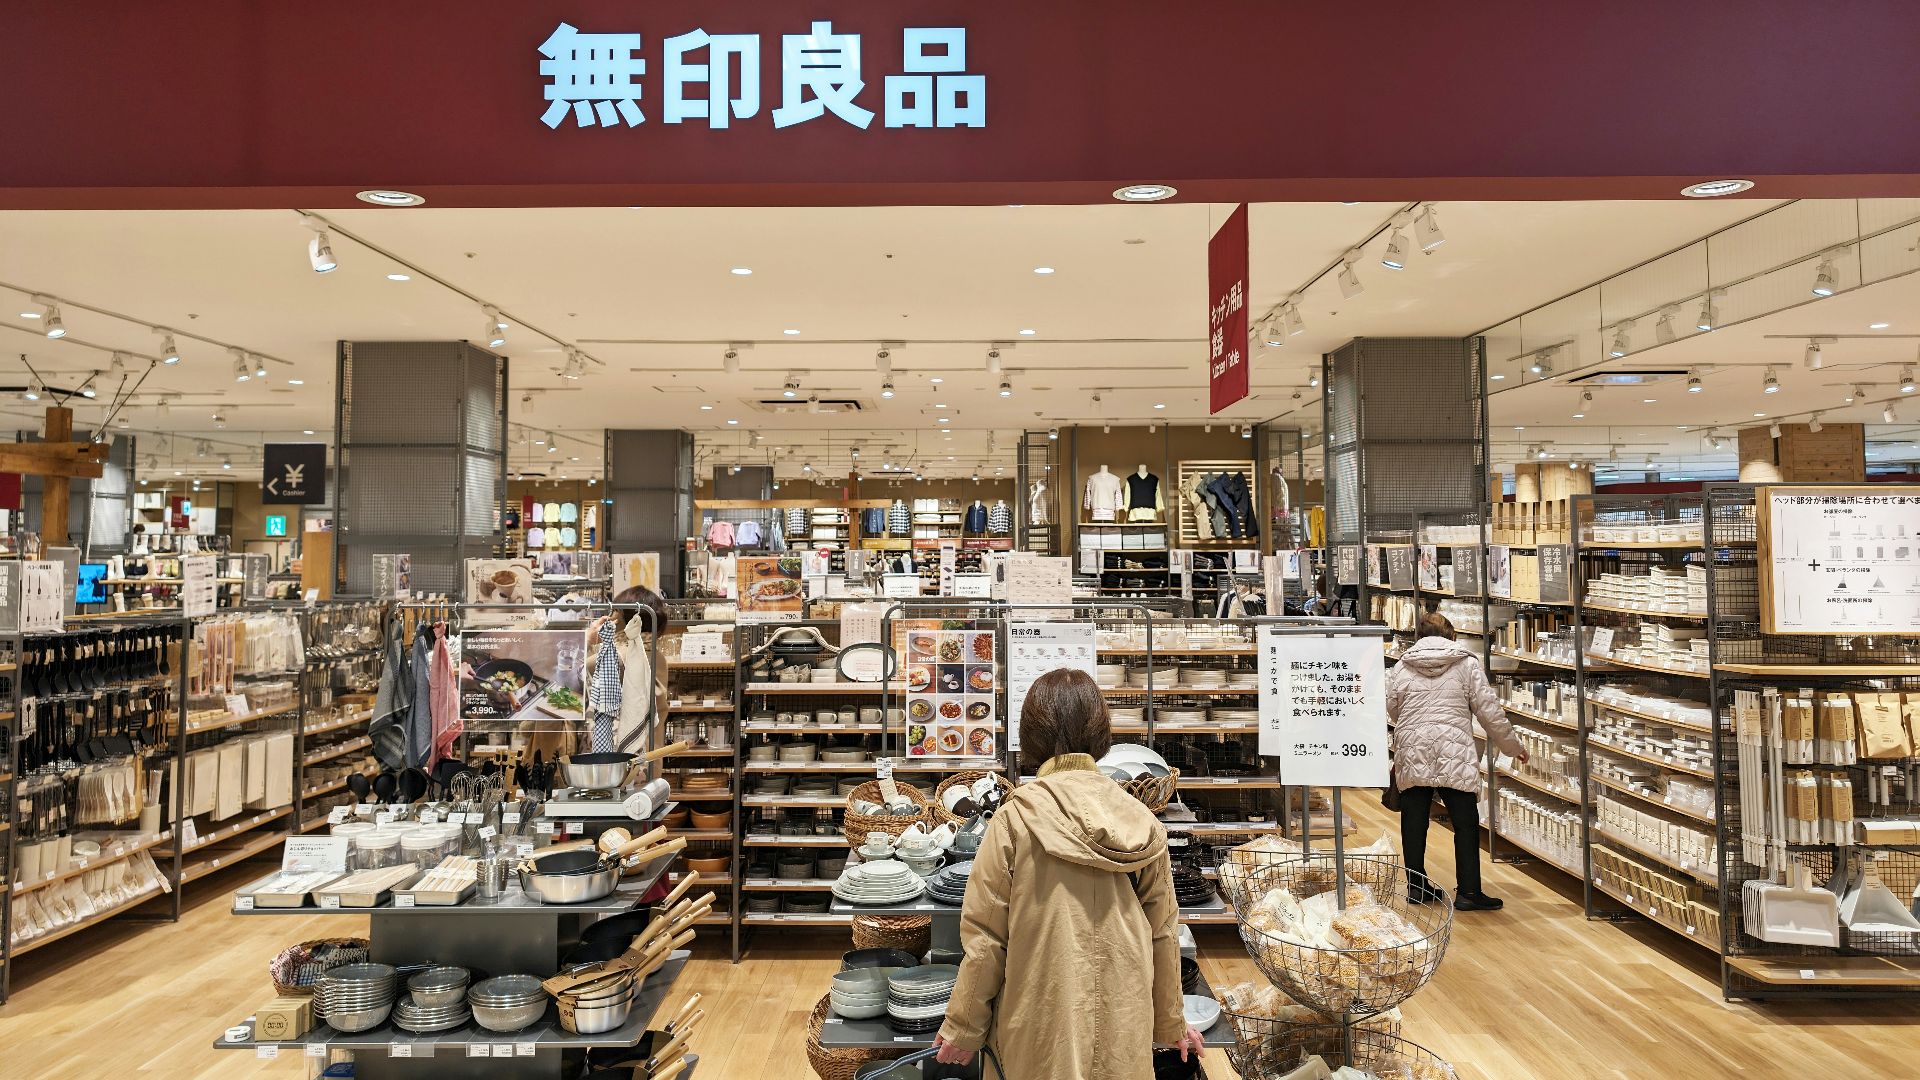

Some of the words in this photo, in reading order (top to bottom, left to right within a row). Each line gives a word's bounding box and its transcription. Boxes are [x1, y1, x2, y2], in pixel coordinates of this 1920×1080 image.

[538, 21, 986, 130] 無印良品
[1211, 279, 1243, 330] キッチン用品
[1212, 326, 1224, 360] 食器
[1392, 549, 1400, 574] コンテナ
[1398, 549, 1406, 568] フード
[1457, 549, 1465, 572] 弁当箱
[1464, 549, 1473, 584] マグボトル
[1543, 547, 1554, 582] 保存容器
[1552, 547, 1562, 573] 冷水筒
[1290, 661, 1348, 670] 麺にチキン味を
[1290, 673, 1362, 682] つけました。お湯を
[1291, 685, 1362, 694] かけても、そのまま
[472, 706, 494, 715] 3,990
[1292, 696, 1365, 705] でも手軽においしく
[1292, 708, 1346, 717] 食べられます。
[1341, 744, 1367, 757] 399
